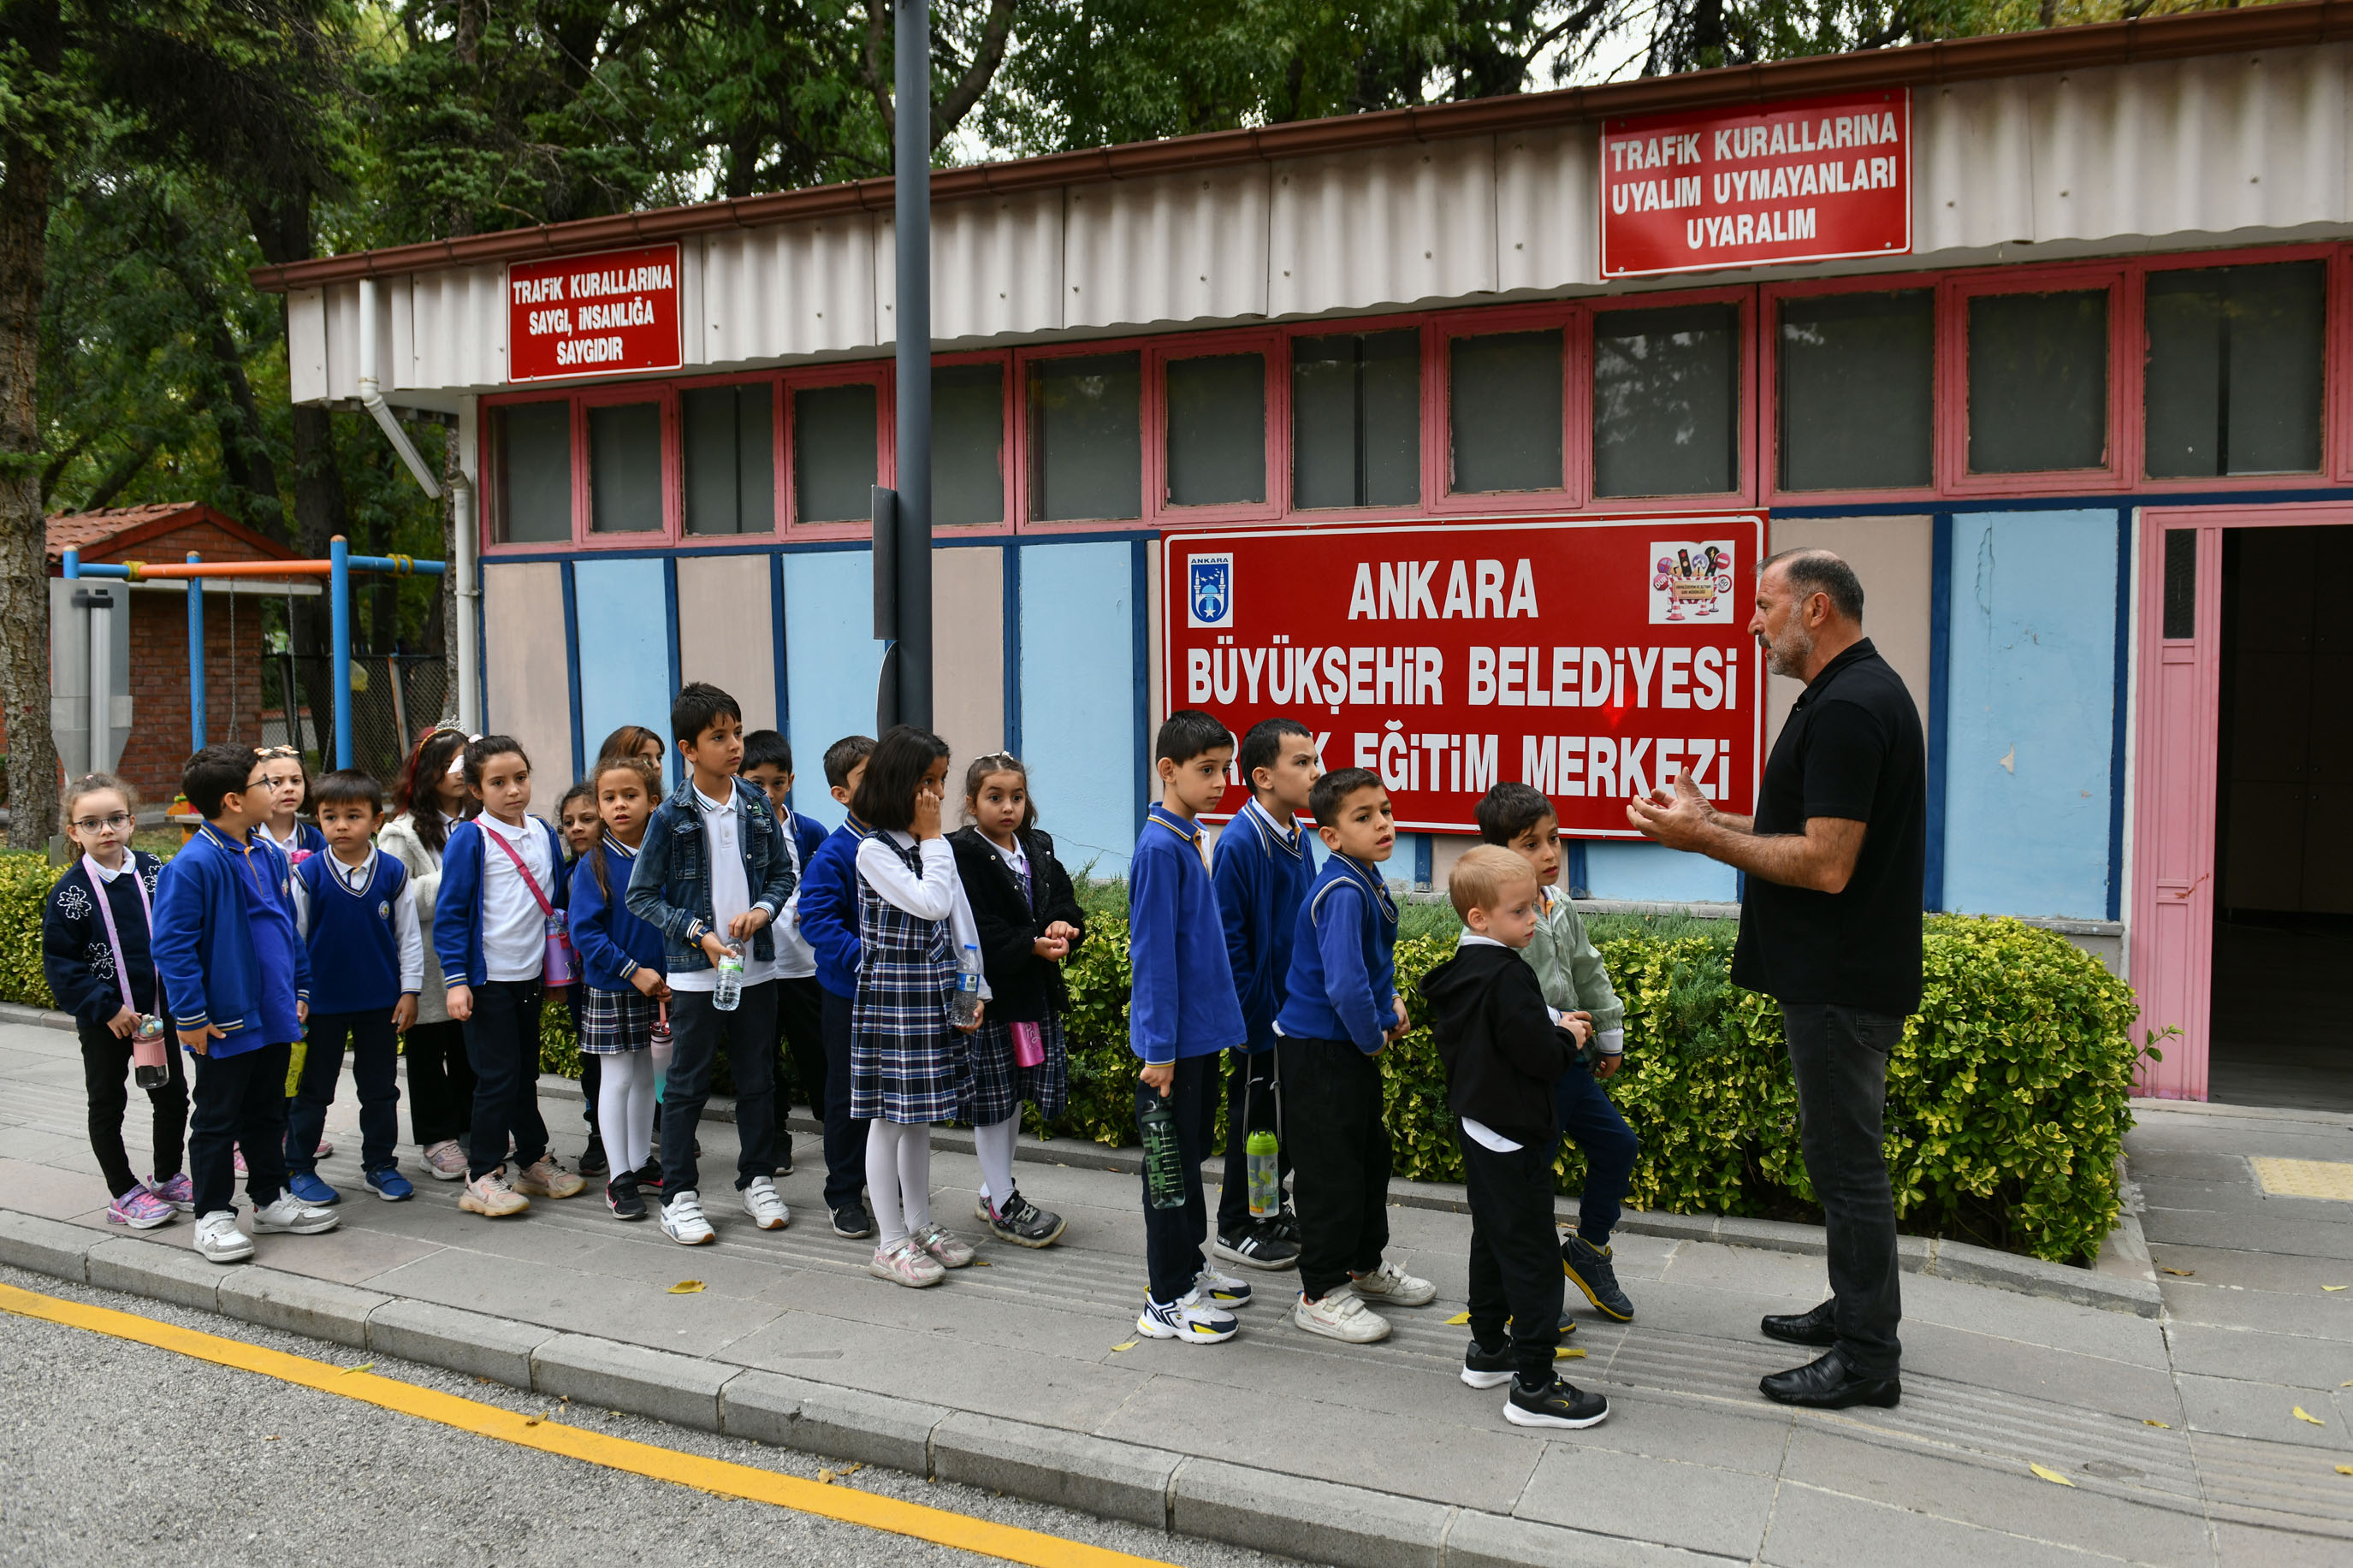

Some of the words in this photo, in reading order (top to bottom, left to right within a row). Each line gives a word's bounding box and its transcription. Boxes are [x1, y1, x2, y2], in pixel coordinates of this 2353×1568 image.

[1714, 112, 1898, 162] KURALLARINA
[1612, 175, 1702, 216] UYALIM
[1713, 156, 1896, 204] UYMAYANLARI
[1686, 207, 1817, 251] UYARALIM
[570, 264, 673, 299] KURALLARINA
[529, 308, 572, 337] SAYGI,
[556, 336, 624, 366] SAYGIDIR
[1348, 558, 1539, 621] ANKARA
